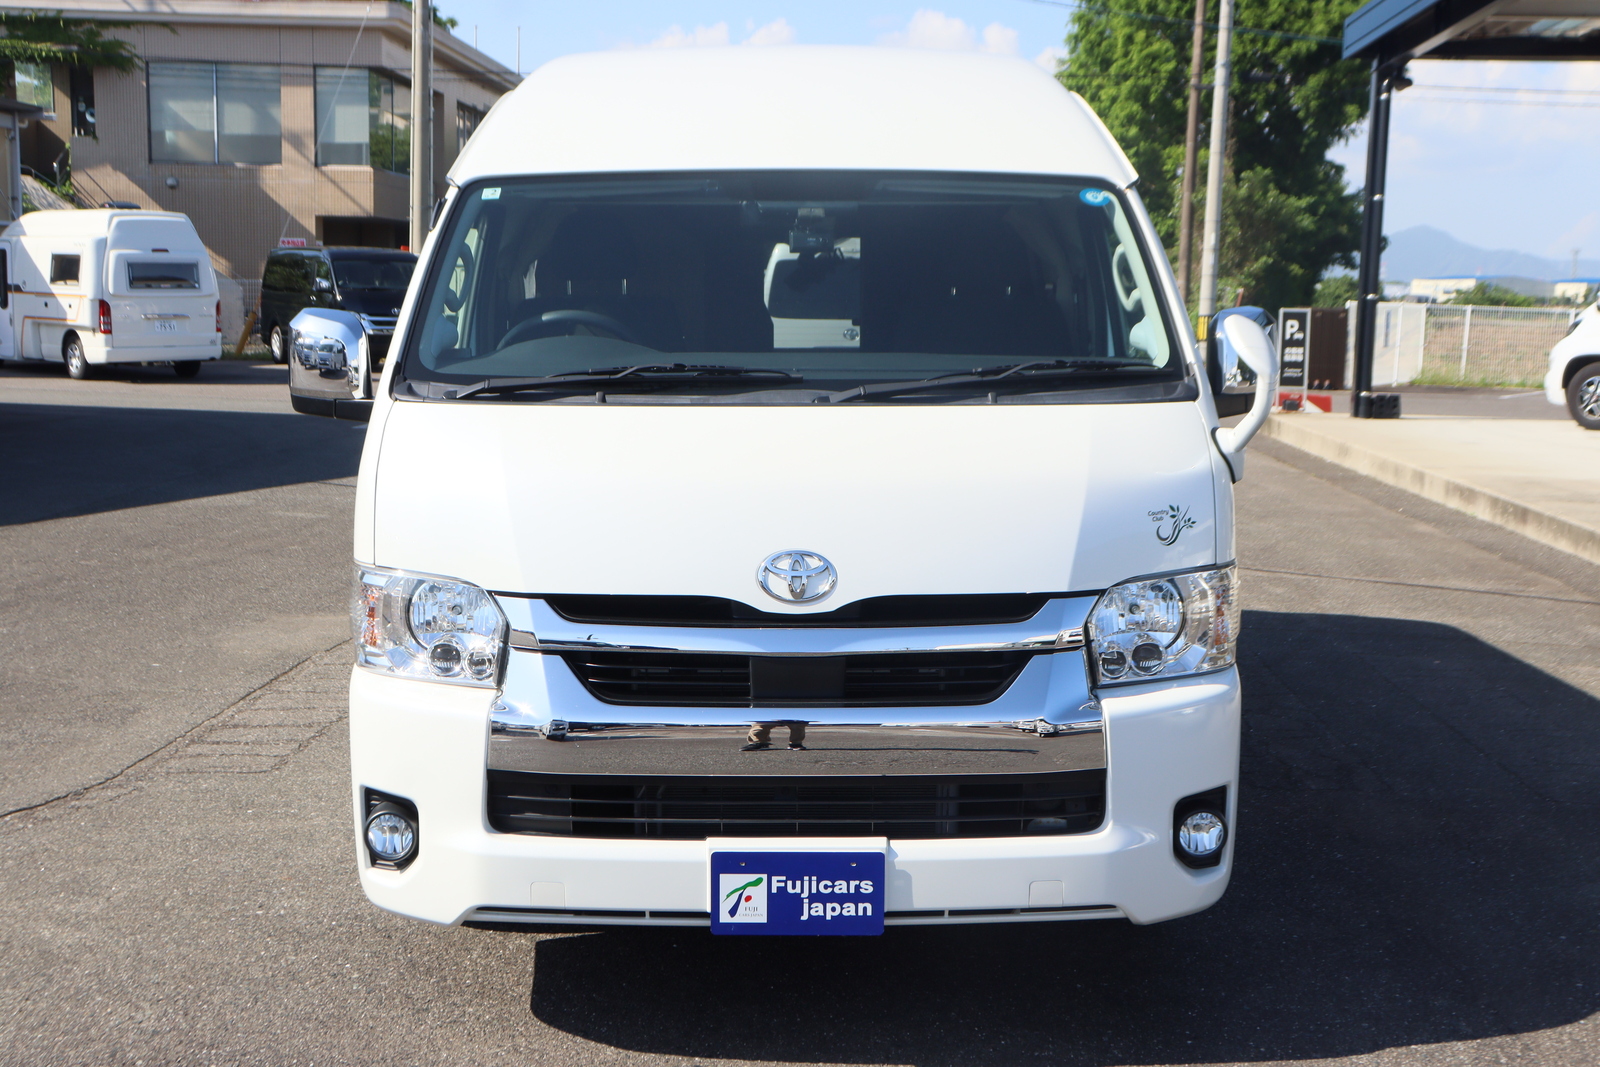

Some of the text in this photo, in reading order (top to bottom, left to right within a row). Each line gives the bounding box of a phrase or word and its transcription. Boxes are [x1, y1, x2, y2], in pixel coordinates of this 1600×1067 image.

[1285, 319, 1299, 340] P
[771, 876, 874, 898] Fujicars
[800, 899, 872, 920] japan
